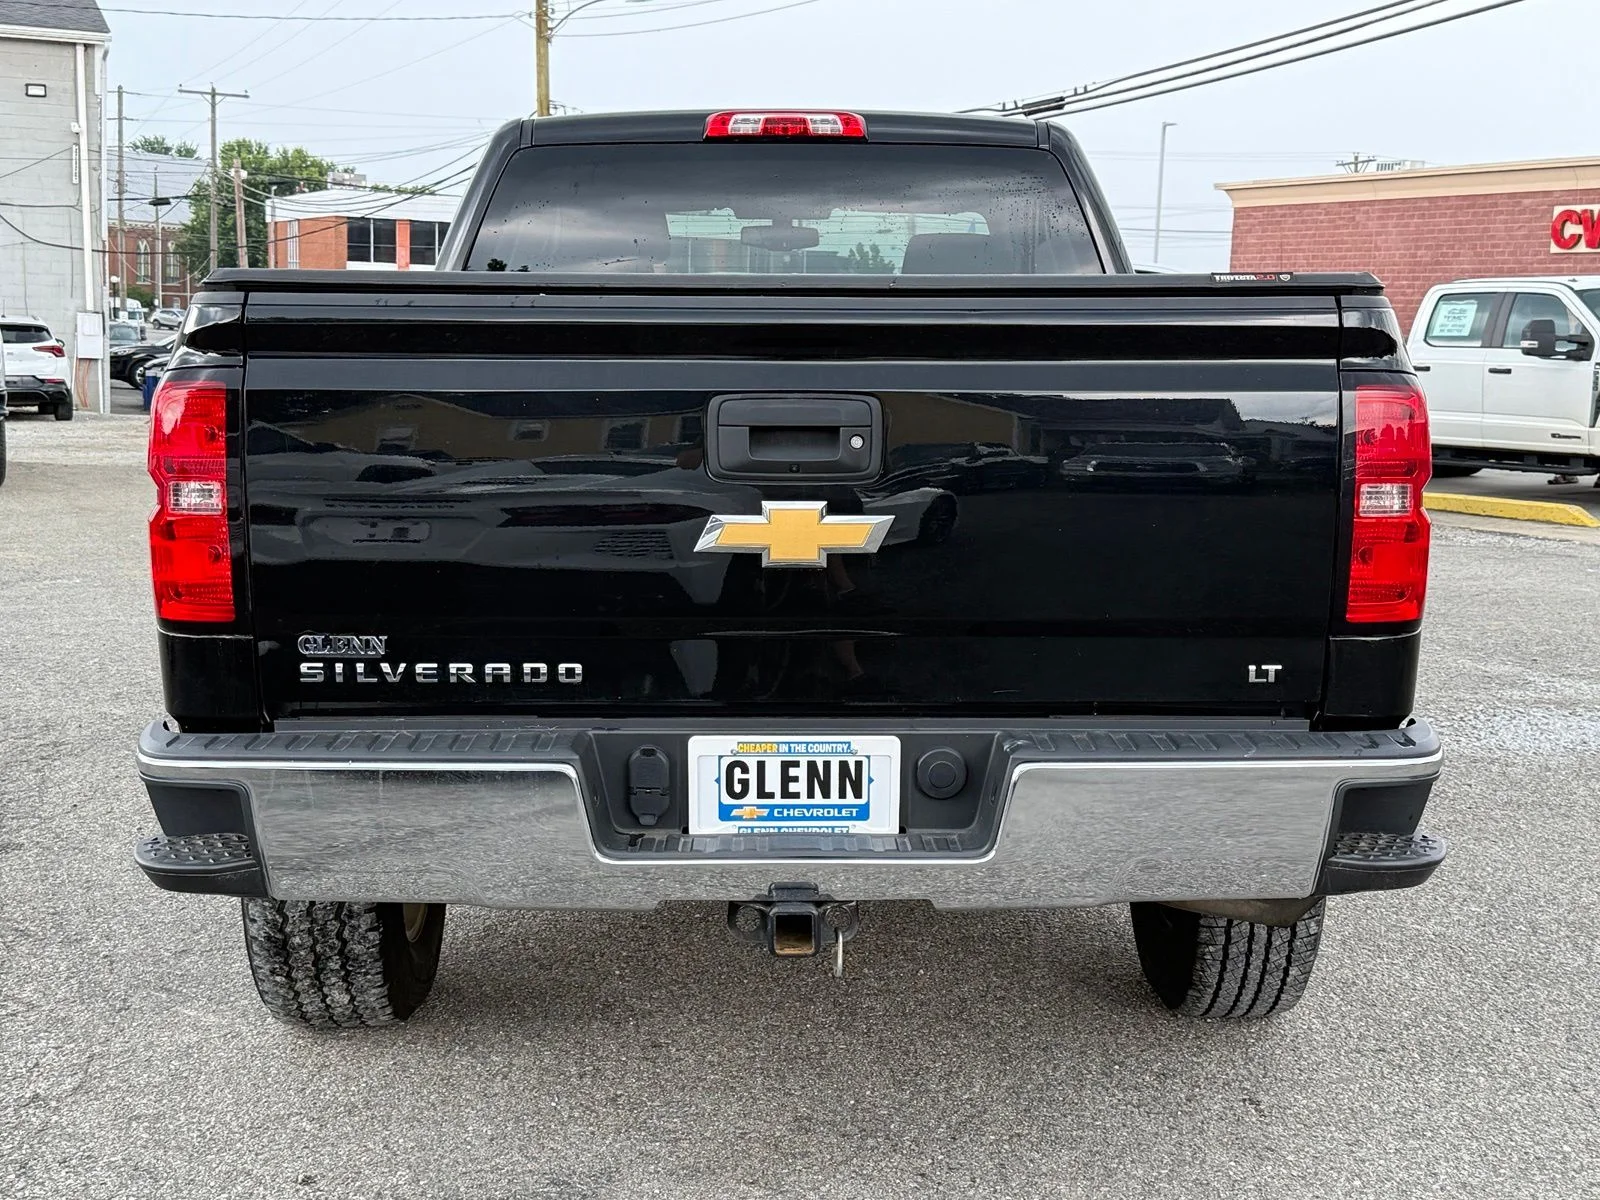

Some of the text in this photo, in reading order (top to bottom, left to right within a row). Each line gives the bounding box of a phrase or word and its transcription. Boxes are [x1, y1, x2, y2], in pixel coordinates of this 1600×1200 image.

[297, 634, 388, 656] GLENN
[299, 662, 583, 684] SILVERADO
[1248, 664, 1283, 683] LT
[738, 743, 778, 753] CHEAPER
[779, 743, 789, 753] IN
[790, 743, 807, 753] THE
[725, 760, 863, 800] GLENN
[773, 808, 859, 817] CHEVROLET
